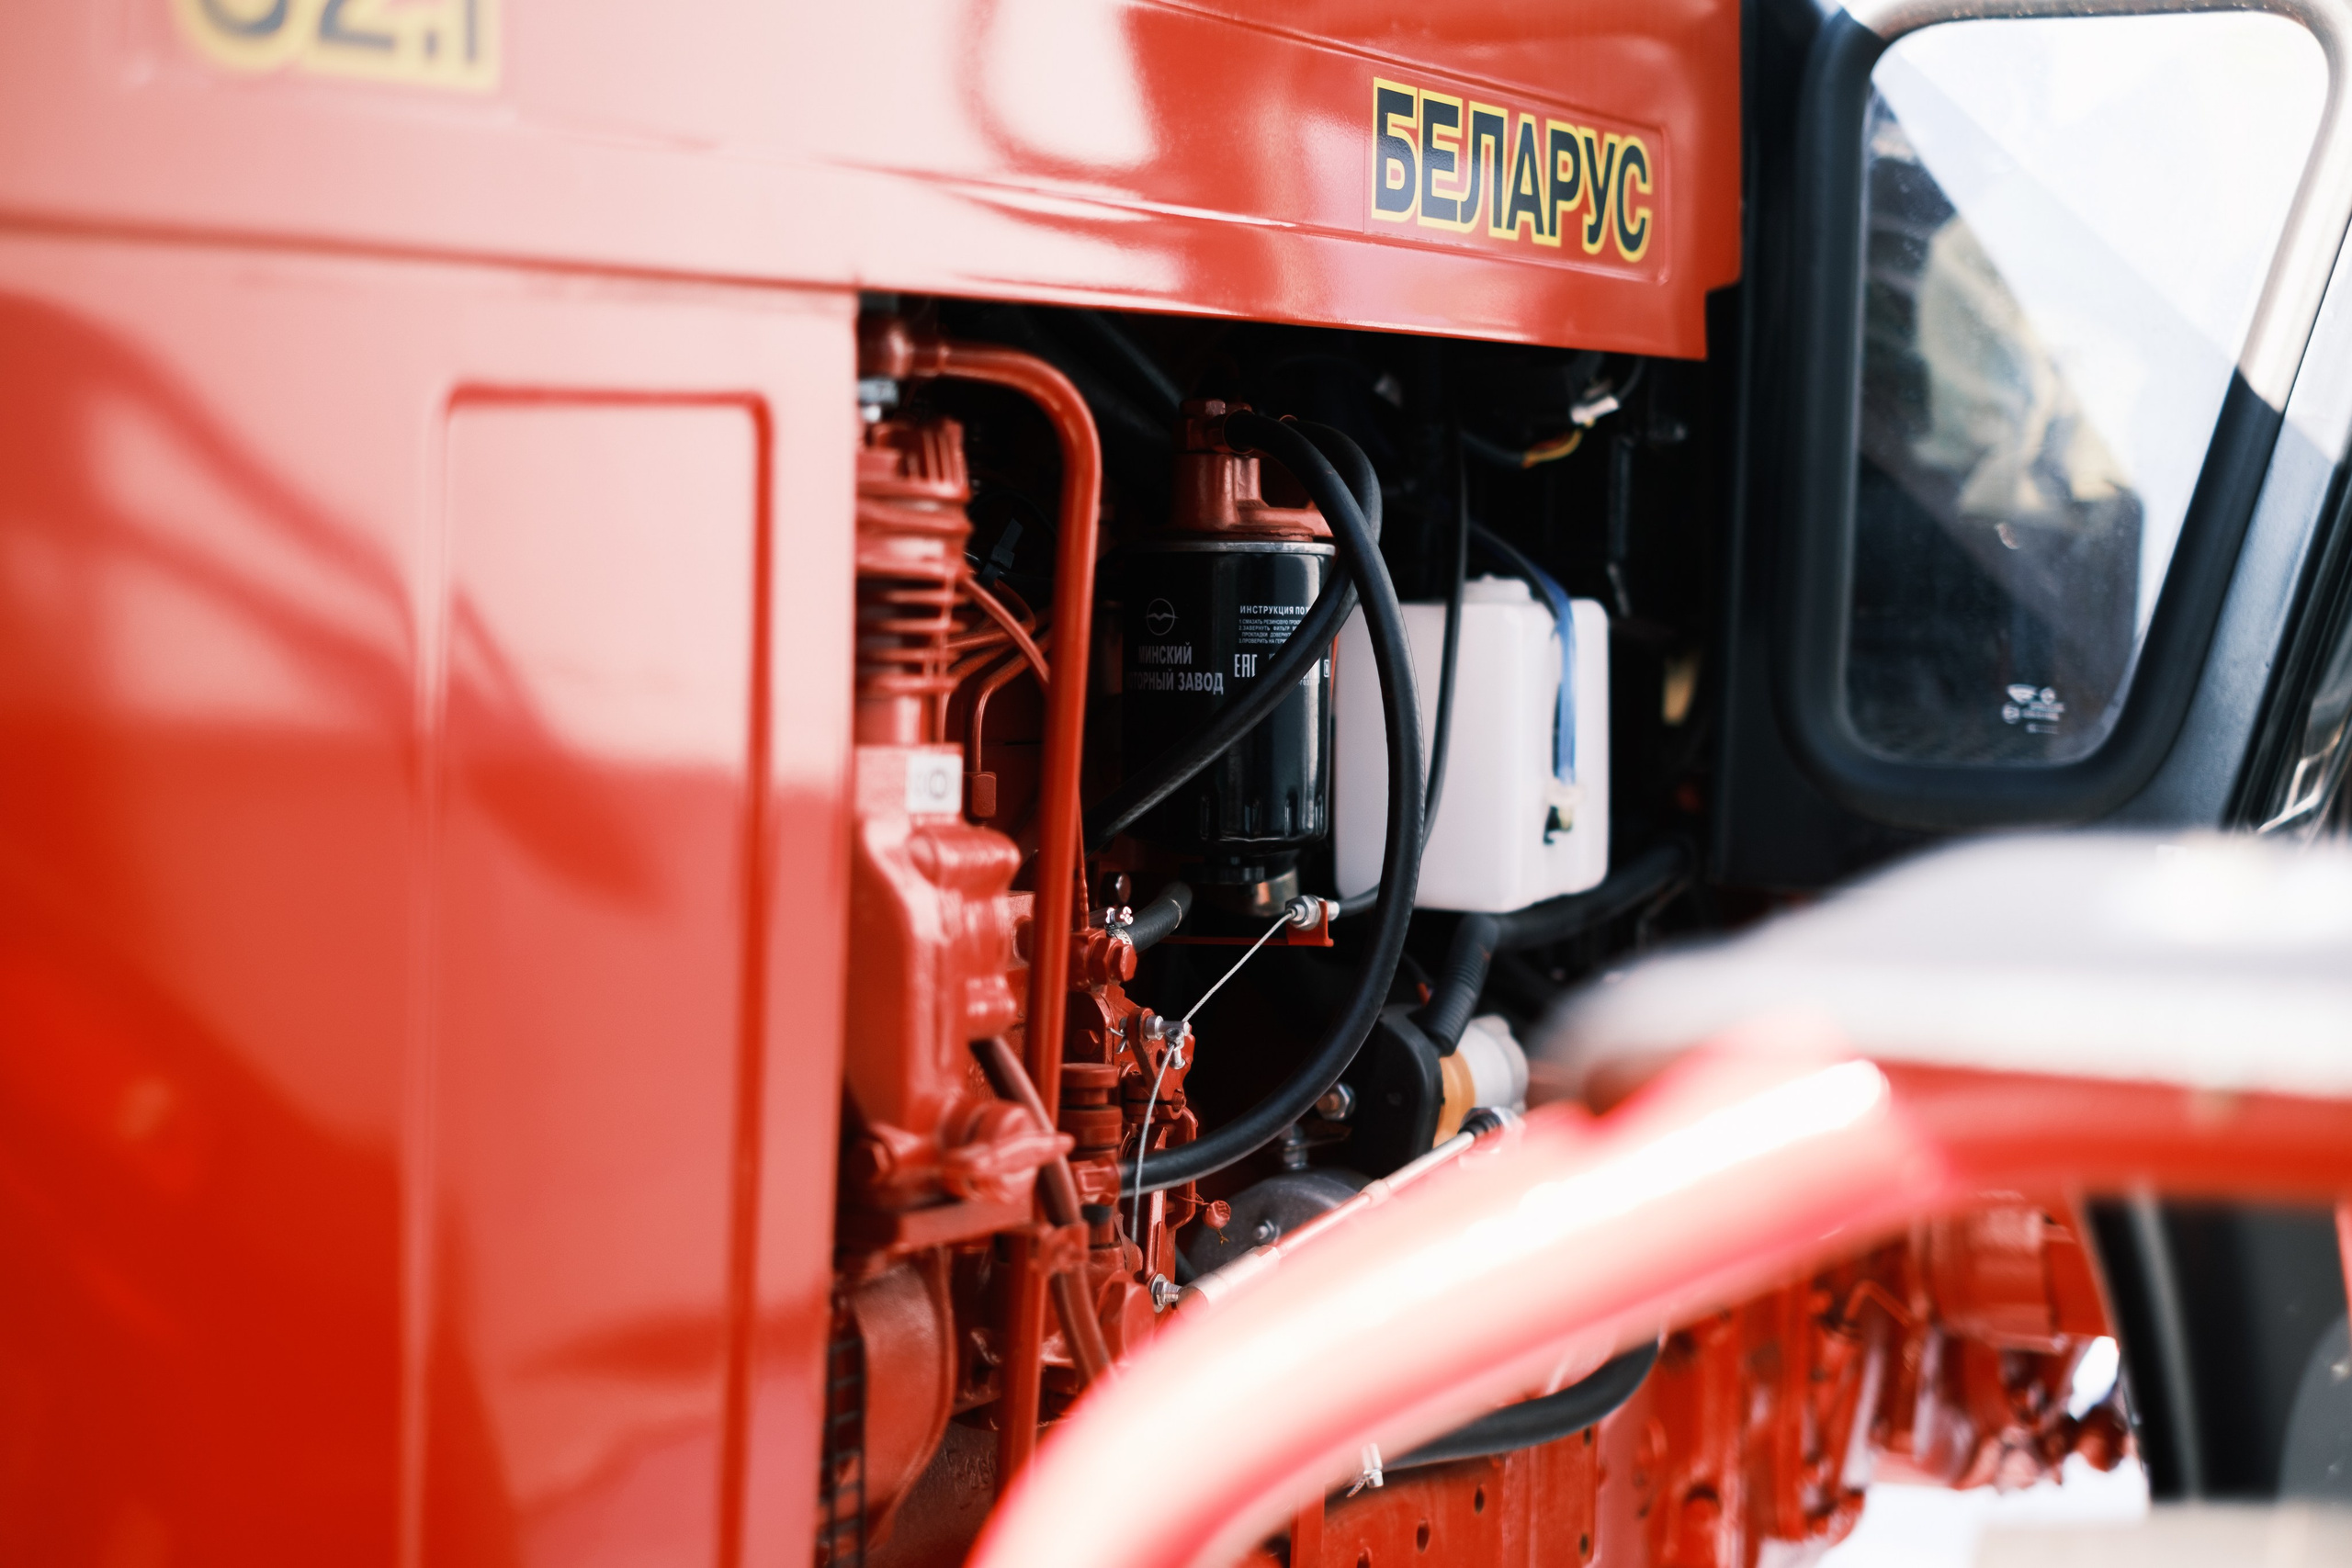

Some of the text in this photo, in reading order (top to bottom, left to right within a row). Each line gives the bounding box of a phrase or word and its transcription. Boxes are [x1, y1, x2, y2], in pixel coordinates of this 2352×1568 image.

[1372, 78, 1651, 261] БЕЛАРУС
[1239, 605, 1295, 615] ИНСТРУКЦИЯ
[1178, 671, 1224, 695] ЗАВОД
